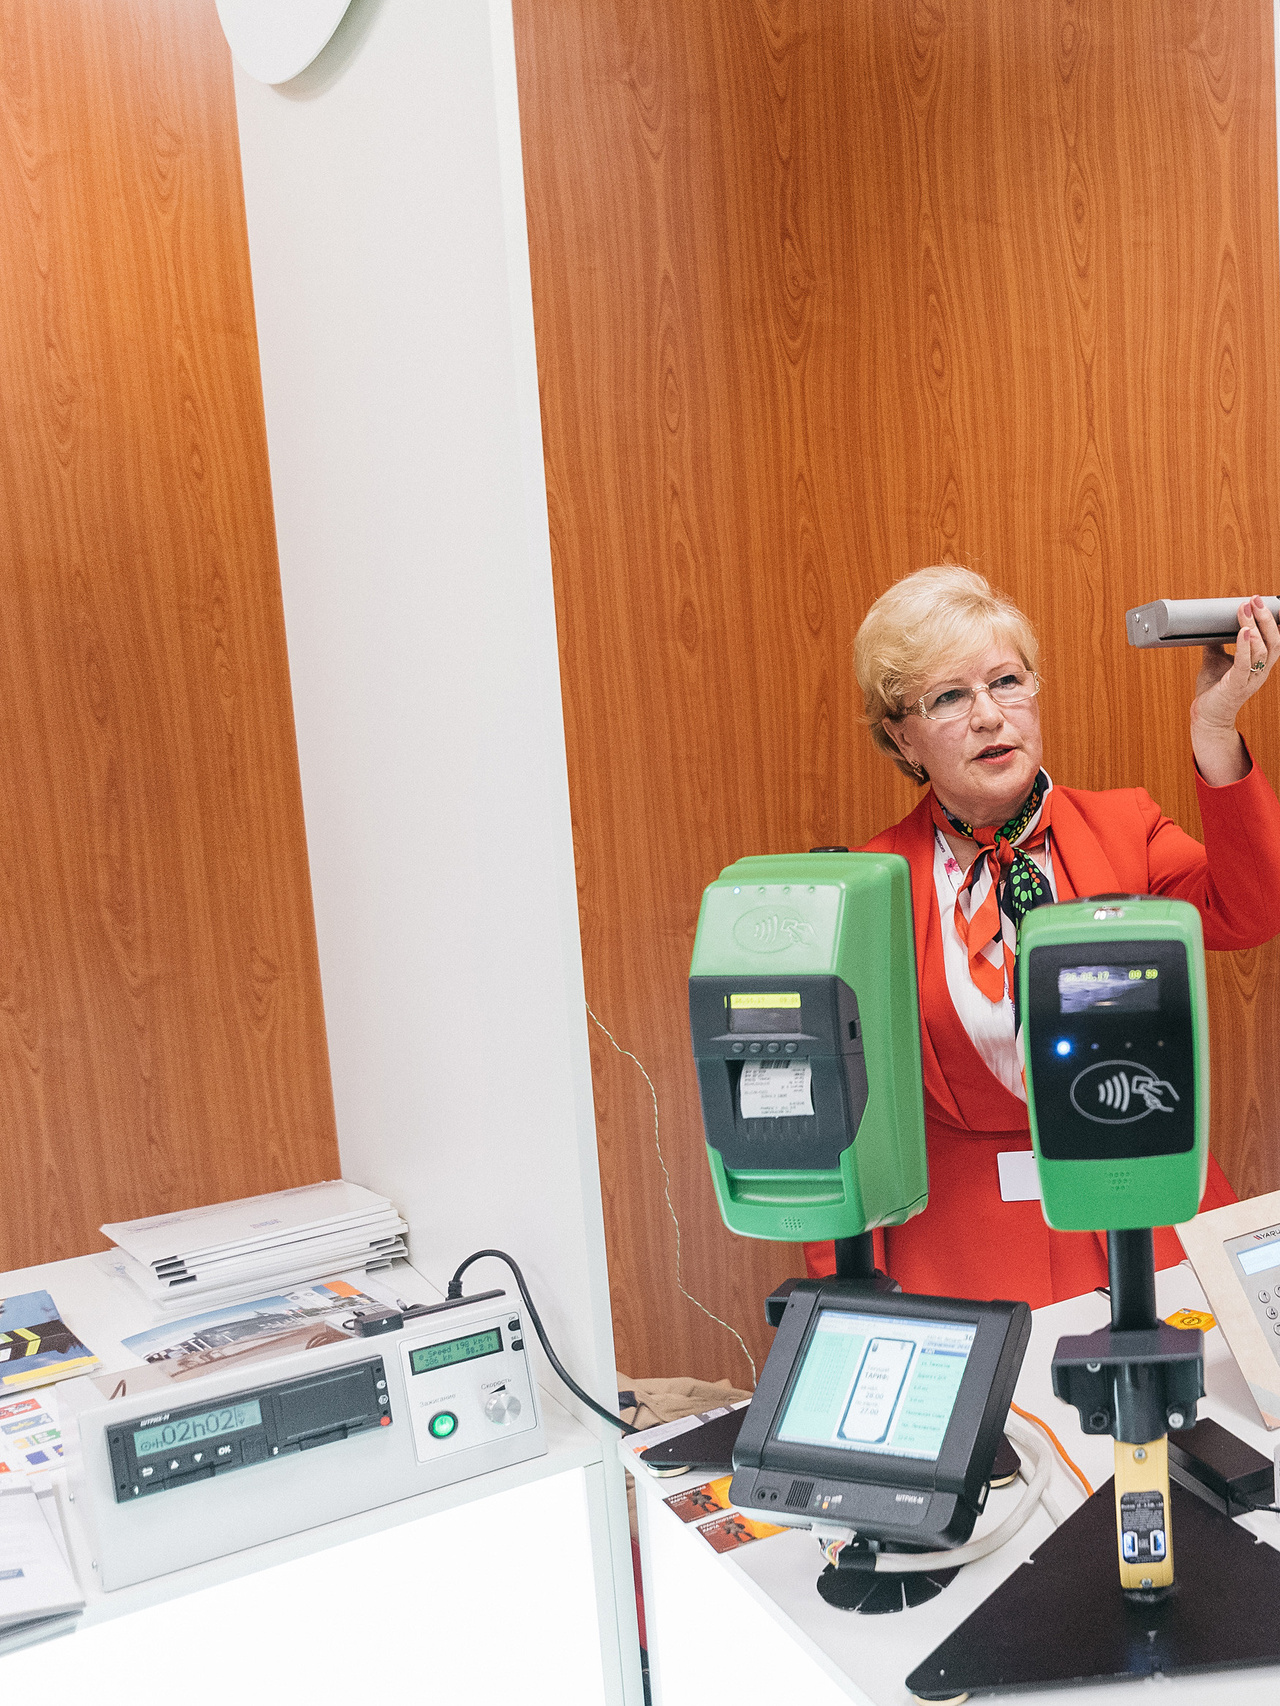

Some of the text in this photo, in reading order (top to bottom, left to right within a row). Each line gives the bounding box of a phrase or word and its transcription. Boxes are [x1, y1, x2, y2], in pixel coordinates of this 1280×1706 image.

[481, 1378, 512, 1390] Скорость
[420, 1394, 456, 1407] Зажигание
[218, 1445, 231, 1456] OK
